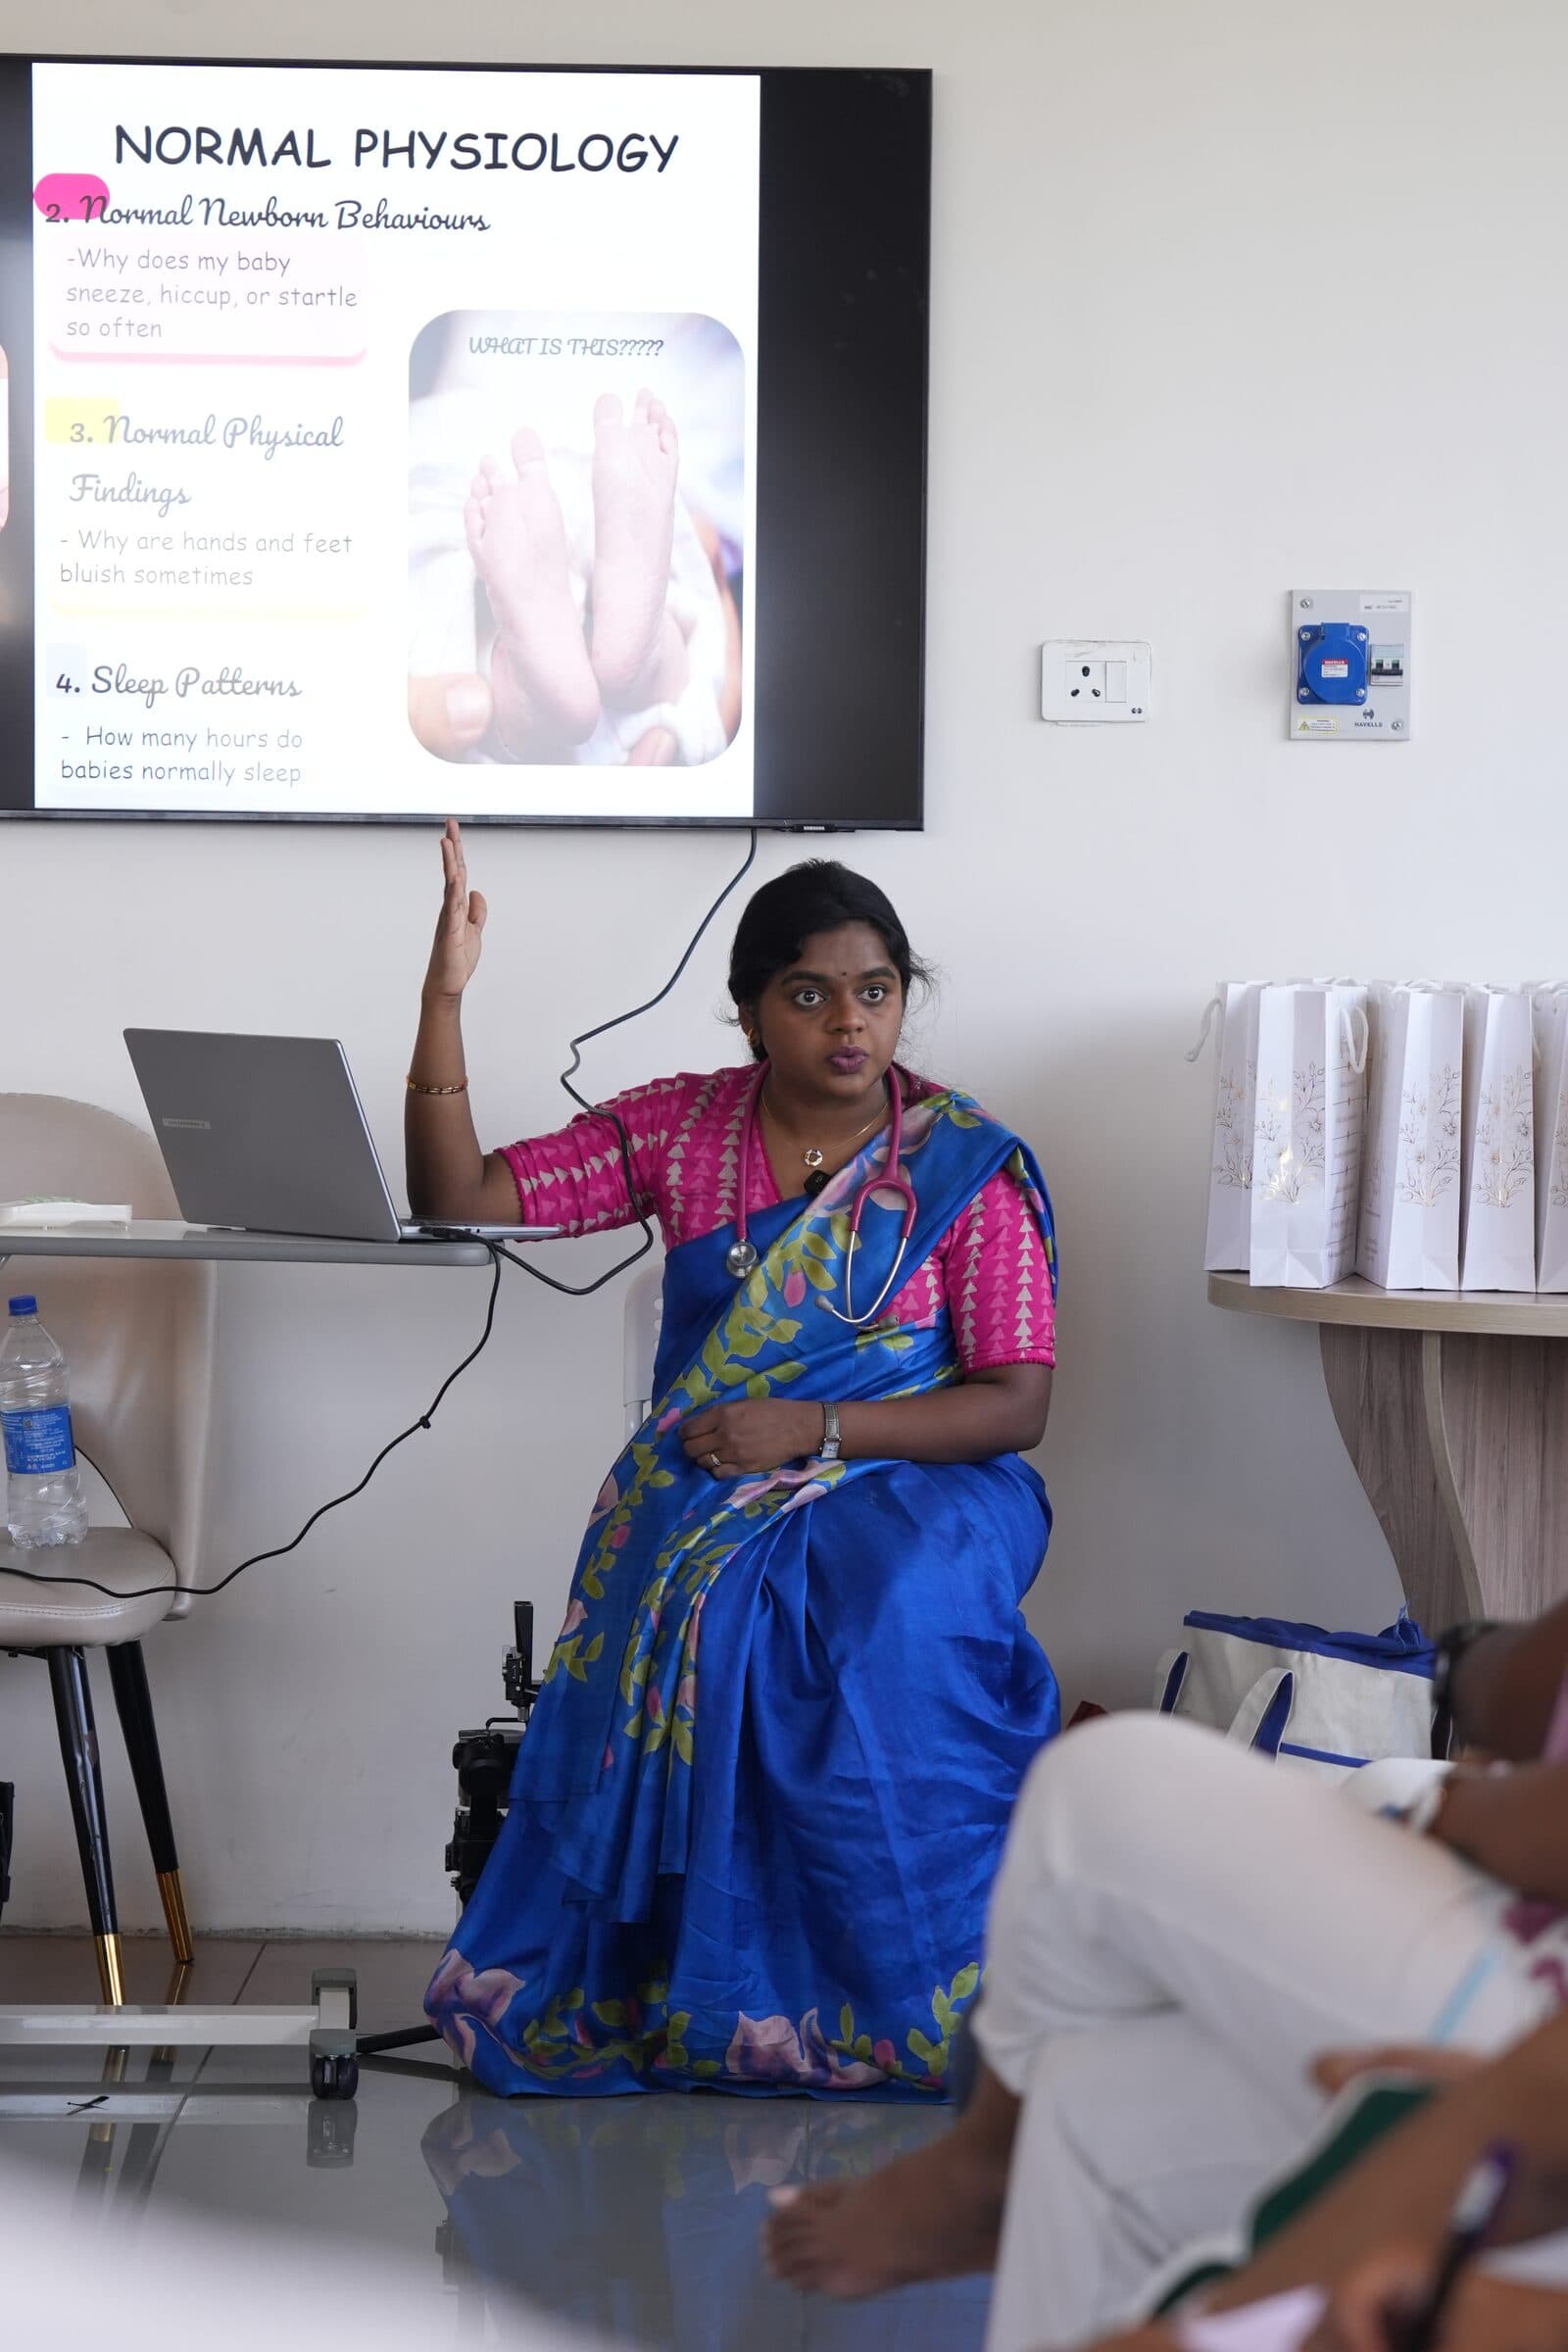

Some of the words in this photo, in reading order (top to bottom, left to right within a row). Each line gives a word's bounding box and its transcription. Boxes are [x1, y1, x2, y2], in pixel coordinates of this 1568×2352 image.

[116, 124, 331, 168] NORMAL
[355, 128, 679, 172] PHYSIOLOGY
[45, 203, 70, 223] 2.
[80, 193, 193, 226] Normal
[199, 196, 328, 227] Newborn
[335, 198, 491, 231] Behaviours
[137, 249, 188, 270] does
[198, 256, 228, 275] my
[238, 251, 290, 277] baby
[67, 286, 151, 307] sneeze,
[161, 283, 237, 310] hiccup,
[247, 292, 270, 305] or
[278, 286, 357, 307] startle
[67, 321, 90, 336] so
[99, 316, 162, 337] often
[469, 337, 535, 355] WHAT
[539, 338, 563, 355] IS
[70, 422, 94, 444] 3.
[102, 414, 216, 446] Normal
[223, 415, 344, 461] Physical
[70, 471, 191, 517] Findings
[78, 529, 128, 556] Why
[137, 536, 173, 551] are
[183, 531, 247, 552] hands
[256, 533, 294, 552] and
[304, 532, 352, 553] feet
[61, 563, 124, 583] bluish
[134, 566, 253, 585] sometimes
[56, 674, 80, 693] 4.
[91, 663, 168, 709] Sleep
[175, 666, 302, 698] Patterns
[86, 726, 132, 746] How
[142, 732, 197, 753] many
[207, 727, 268, 748] hours
[277, 729, 302, 748] do
[62, 760, 132, 779] babies
[142, 760, 234, 786] normally
[244, 760, 301, 788] sleep
